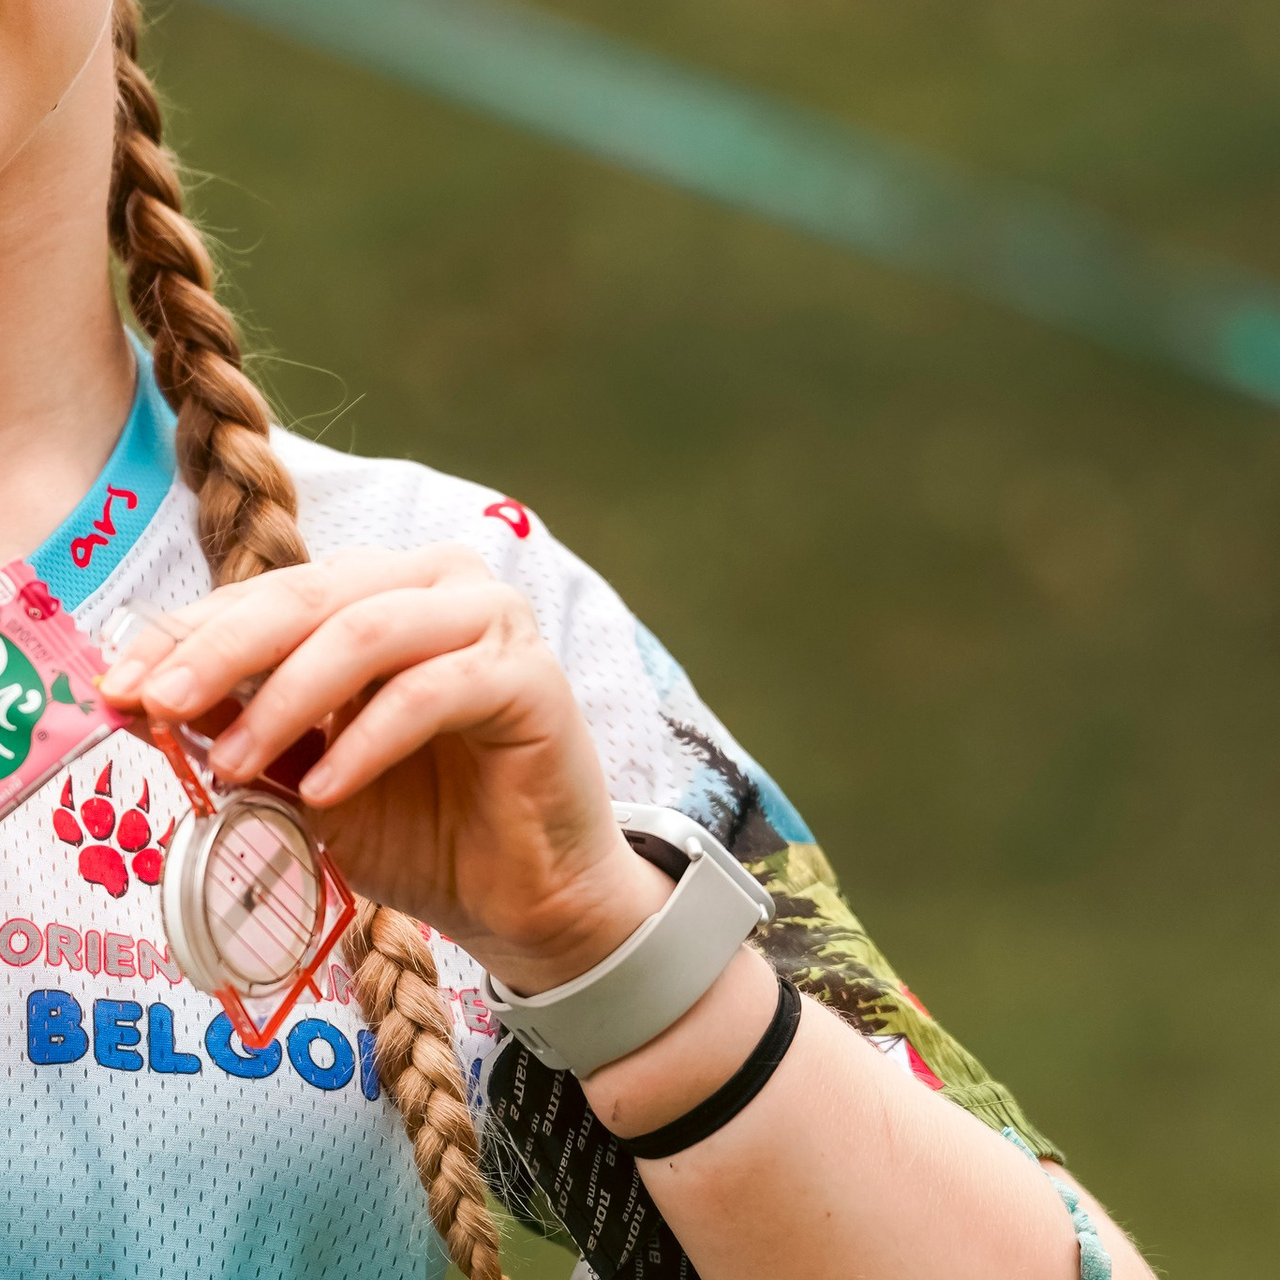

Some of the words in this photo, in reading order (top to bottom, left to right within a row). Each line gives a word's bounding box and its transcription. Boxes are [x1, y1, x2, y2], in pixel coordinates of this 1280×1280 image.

[27, 989, 381, 1101] BELGO
[542, 1070, 565, 1137] name
[622, 1167, 639, 1223] oname
